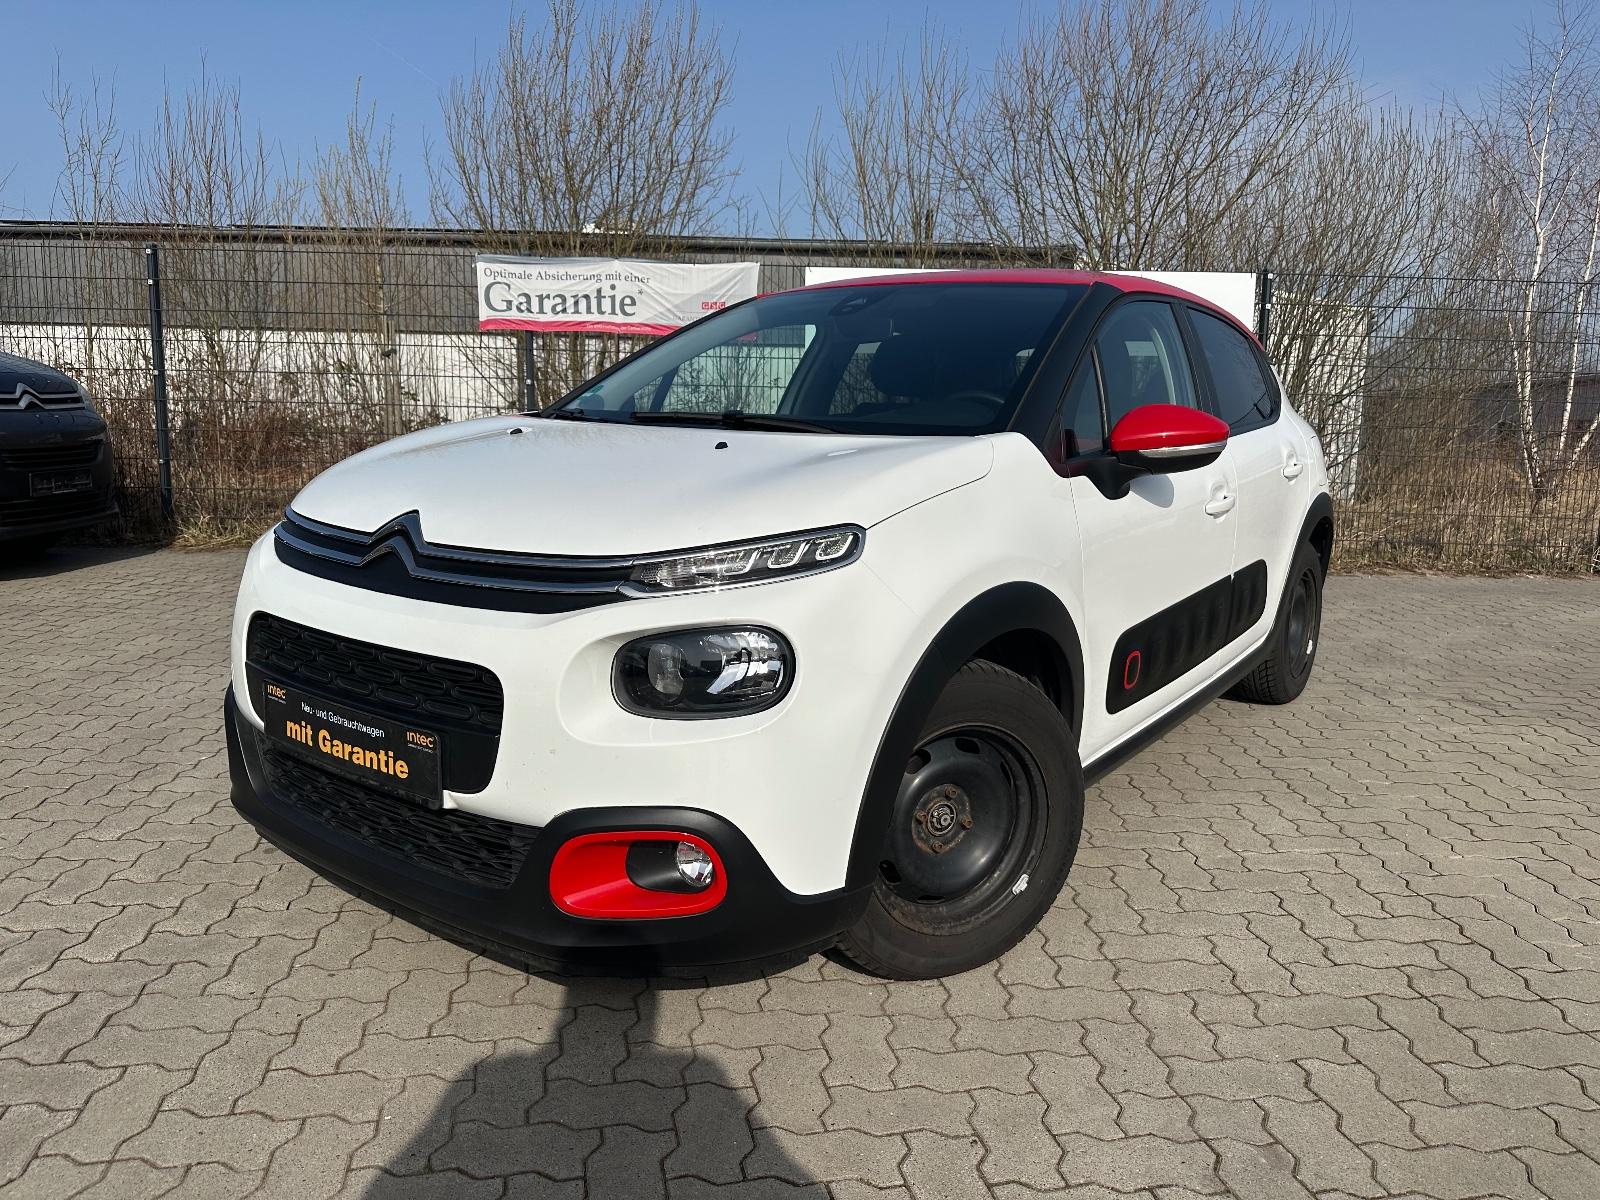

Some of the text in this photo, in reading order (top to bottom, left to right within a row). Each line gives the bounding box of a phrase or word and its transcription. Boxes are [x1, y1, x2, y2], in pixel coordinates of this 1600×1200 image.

[483, 267, 651, 284] Optimale Absicherung mit einer
[267, 684, 287, 699] intec
[301, 701, 385, 738] Neu- und Gebrauchtwagen
[406, 731, 434, 748] intec
[286, 719, 409, 779] mit Garantie
